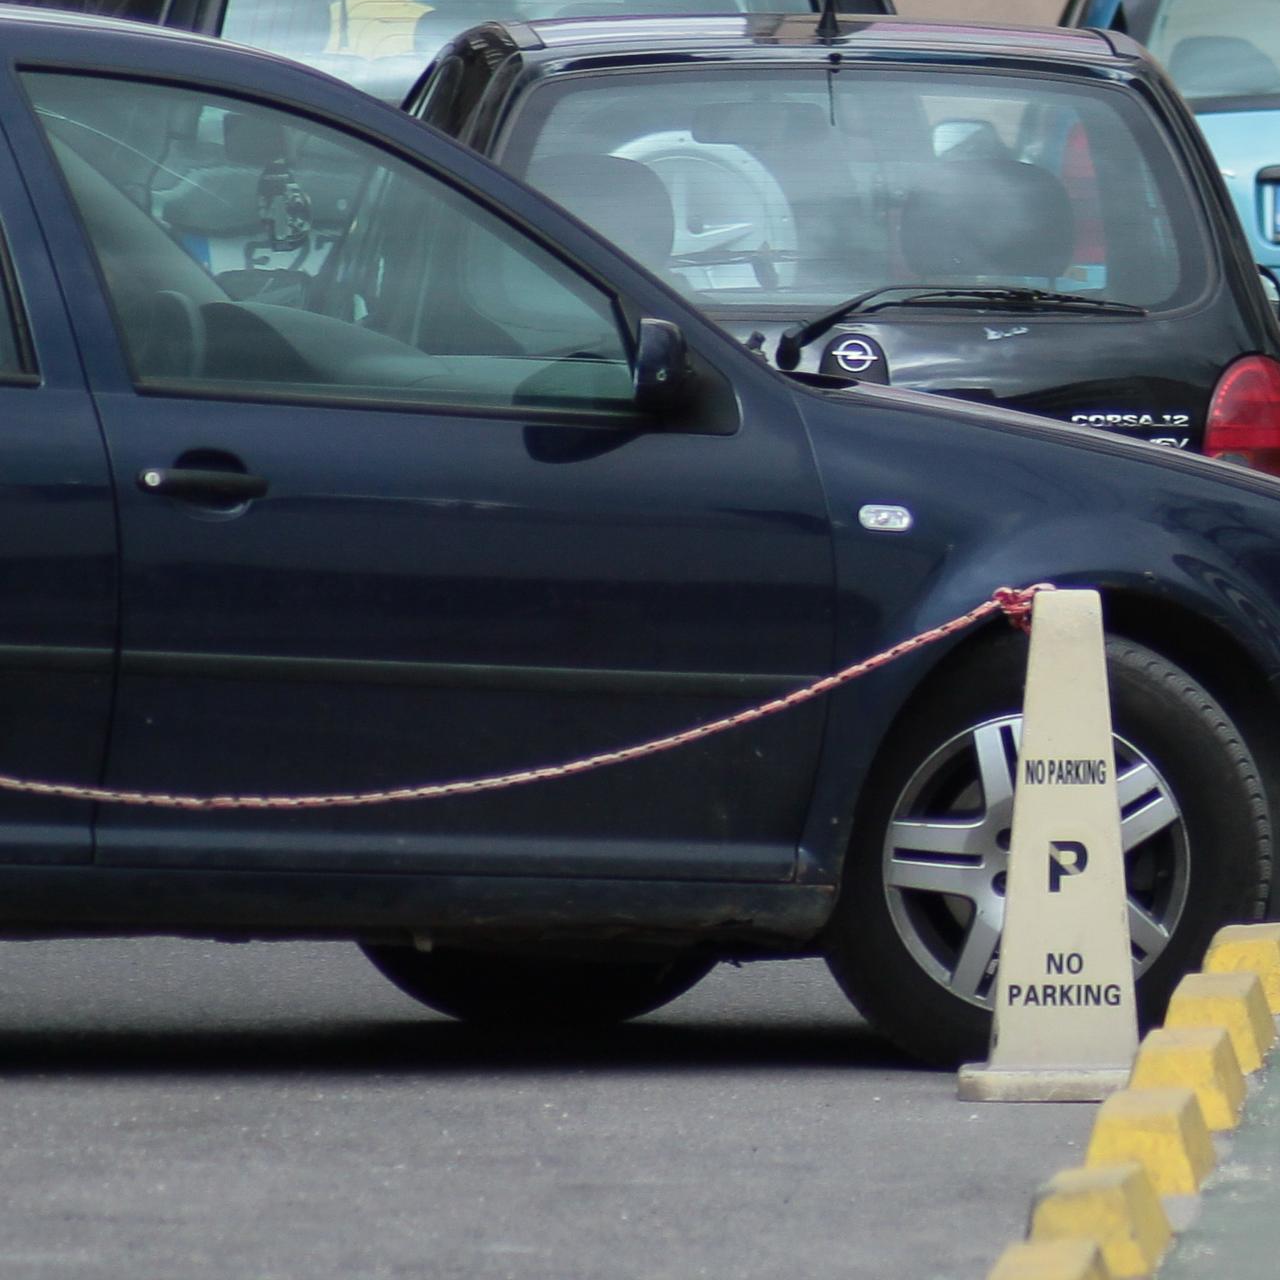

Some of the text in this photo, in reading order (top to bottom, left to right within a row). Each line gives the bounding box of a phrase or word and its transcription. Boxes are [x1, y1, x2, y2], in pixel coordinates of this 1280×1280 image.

[1071, 414, 1154, 427] CORSA
[1025, 759, 1107, 785] NO PARKING
[1046, 952, 1084, 975] NO
[1007, 984, 1122, 1007] PARKING
